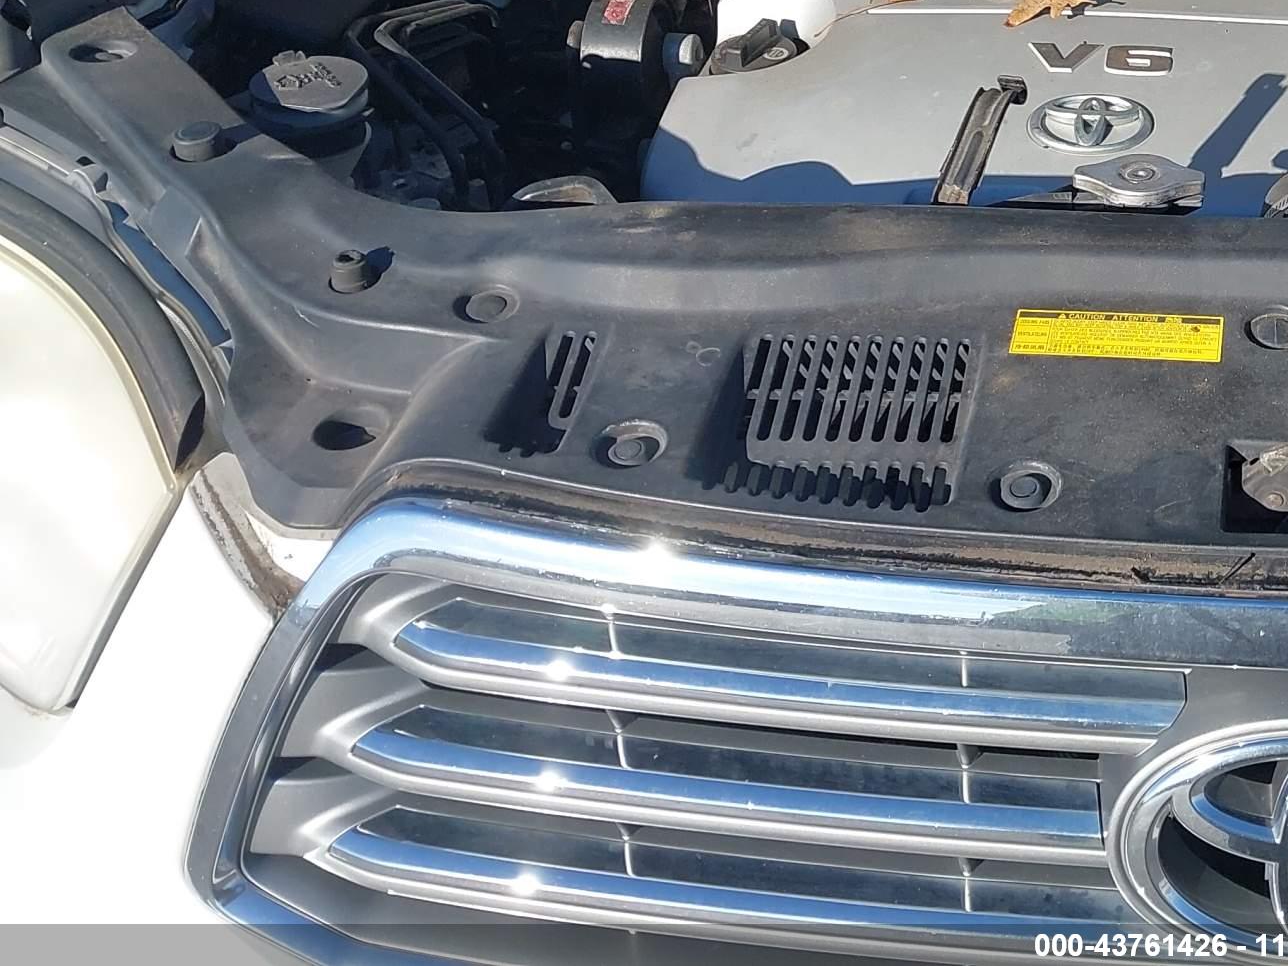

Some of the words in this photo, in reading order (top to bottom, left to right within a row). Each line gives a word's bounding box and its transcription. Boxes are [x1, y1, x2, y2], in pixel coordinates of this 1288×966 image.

[1028, 41, 1174, 76] V6
[1068, 313, 1106, 321] CAUTION
[1112, 315, 1159, 323] ATTENTION
